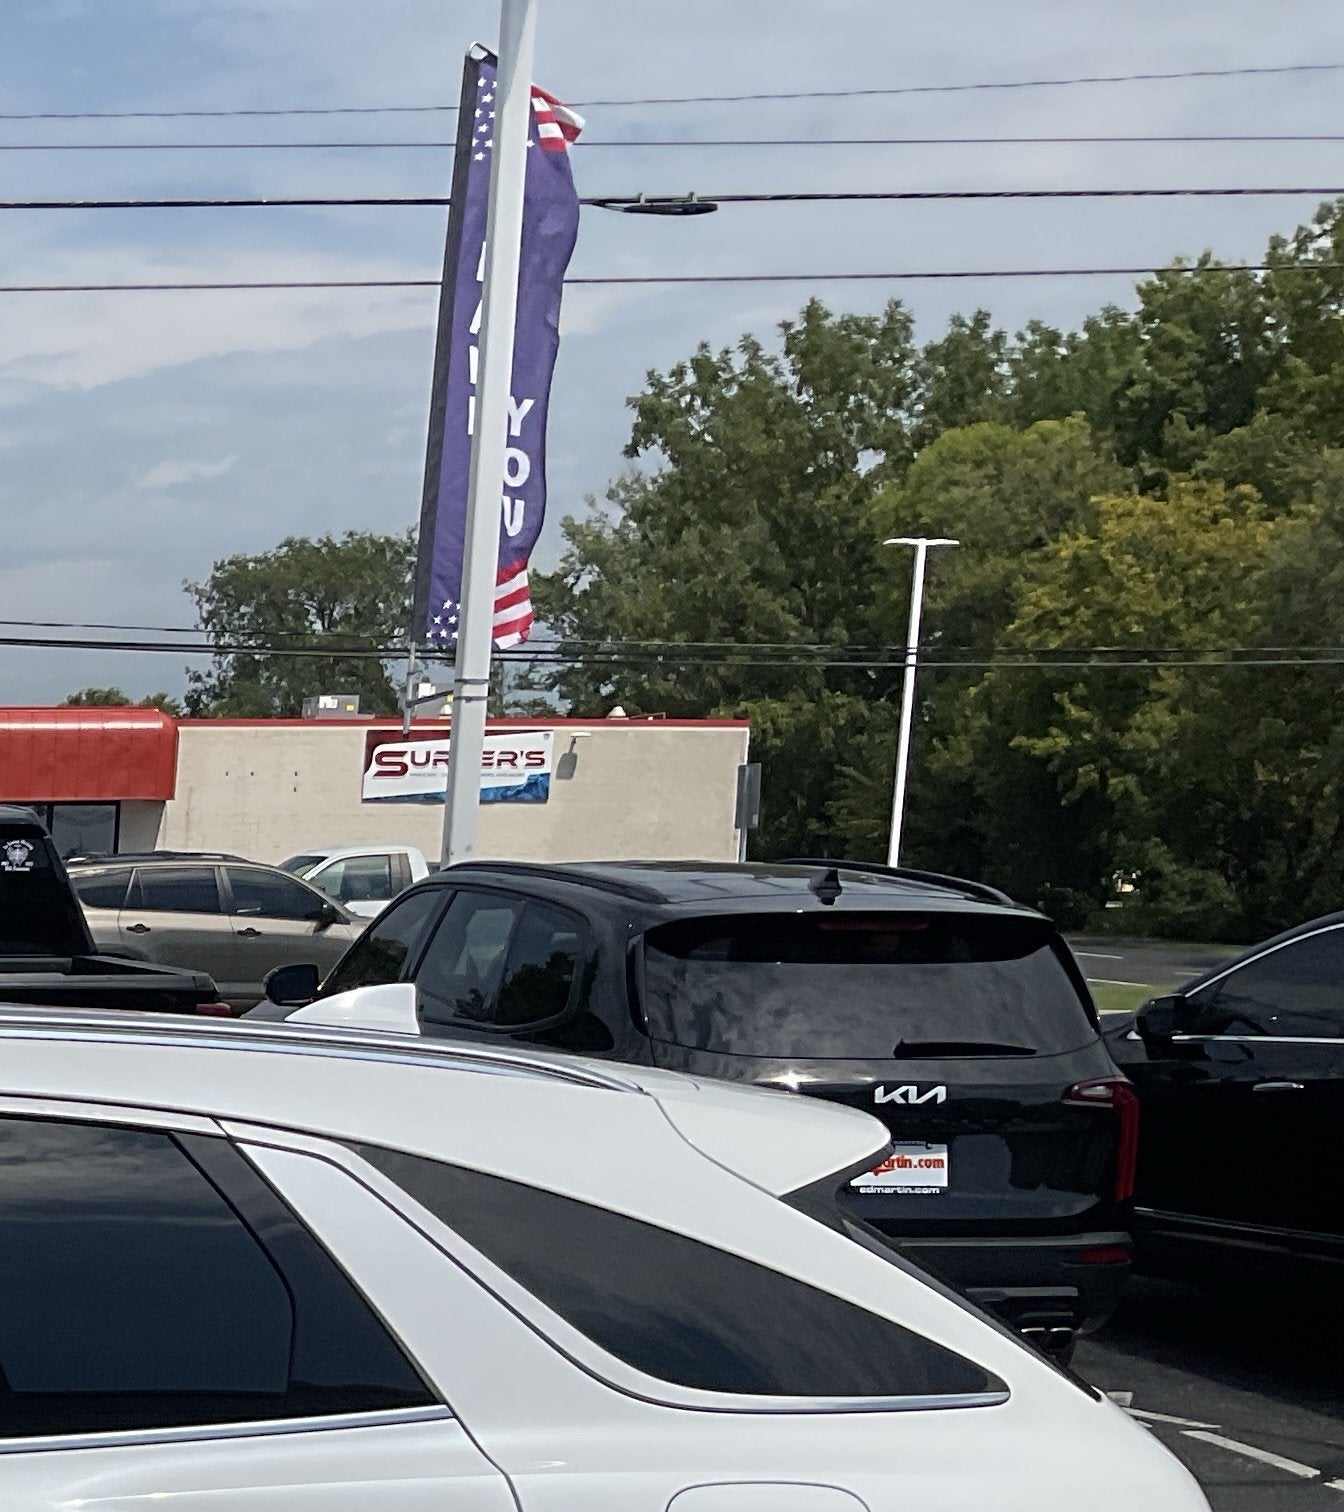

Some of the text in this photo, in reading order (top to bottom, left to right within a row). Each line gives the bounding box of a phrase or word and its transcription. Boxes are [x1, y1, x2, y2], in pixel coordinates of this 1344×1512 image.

[503, 396, 535, 537] YOU
[373, 750, 545, 777] SURER'S
[874, 1085, 947, 1105] KIA
[883, 1155, 945, 1169] artin.com
[859, 1186, 940, 1194] edmartin.com
